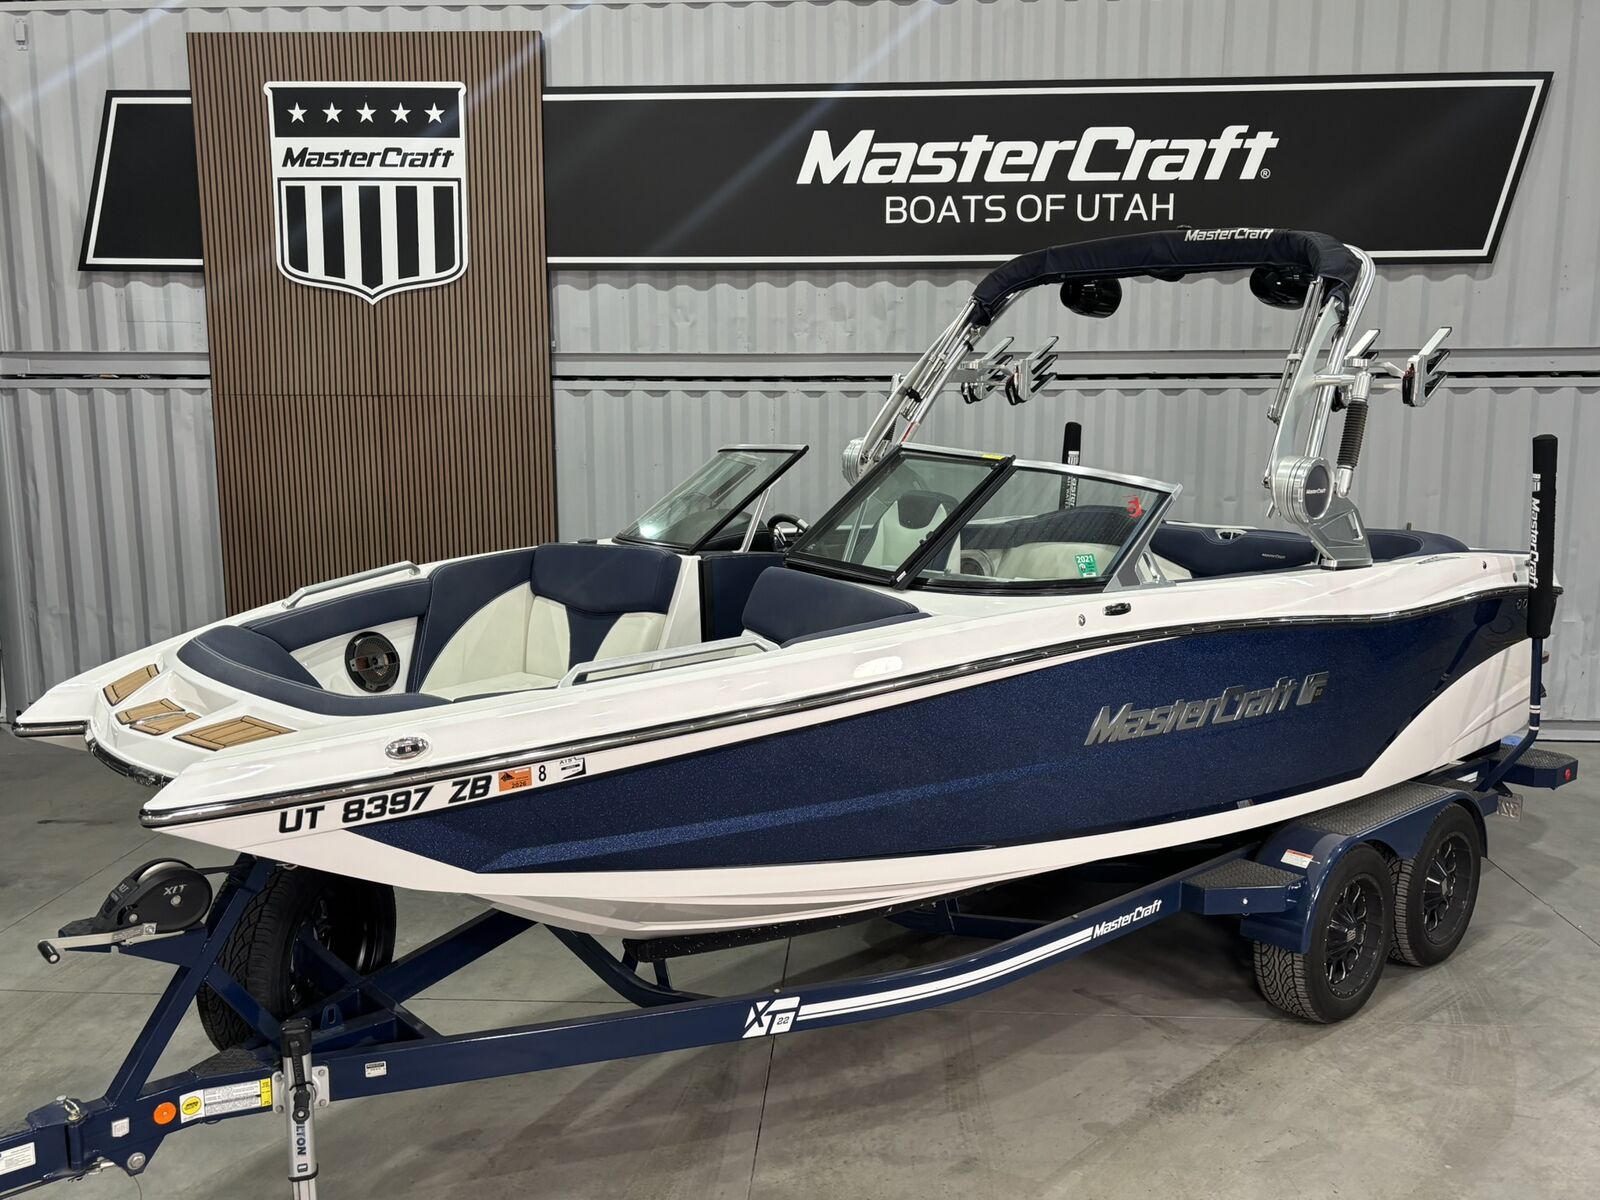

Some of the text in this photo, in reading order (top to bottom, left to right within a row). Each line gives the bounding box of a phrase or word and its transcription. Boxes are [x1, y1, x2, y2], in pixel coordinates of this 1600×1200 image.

[281, 146, 455, 168] MasterCraft
[885, 192, 1176, 224] BOATS OF UTAH
[1184, 228, 1274, 242] MasterCraft
[1529, 496, 1541, 590] MasterCraft
[1075, 554, 1094, 564] 2021
[1083, 675, 1298, 746] MasterCraft
[537, 764, 548, 782] 8
[278, 774, 493, 834] UT 8397 ZB
[163, 884, 188, 896] XLT
[1092, 899, 1163, 939] MasterCraft
[776, 1016, 790, 1026] 22
